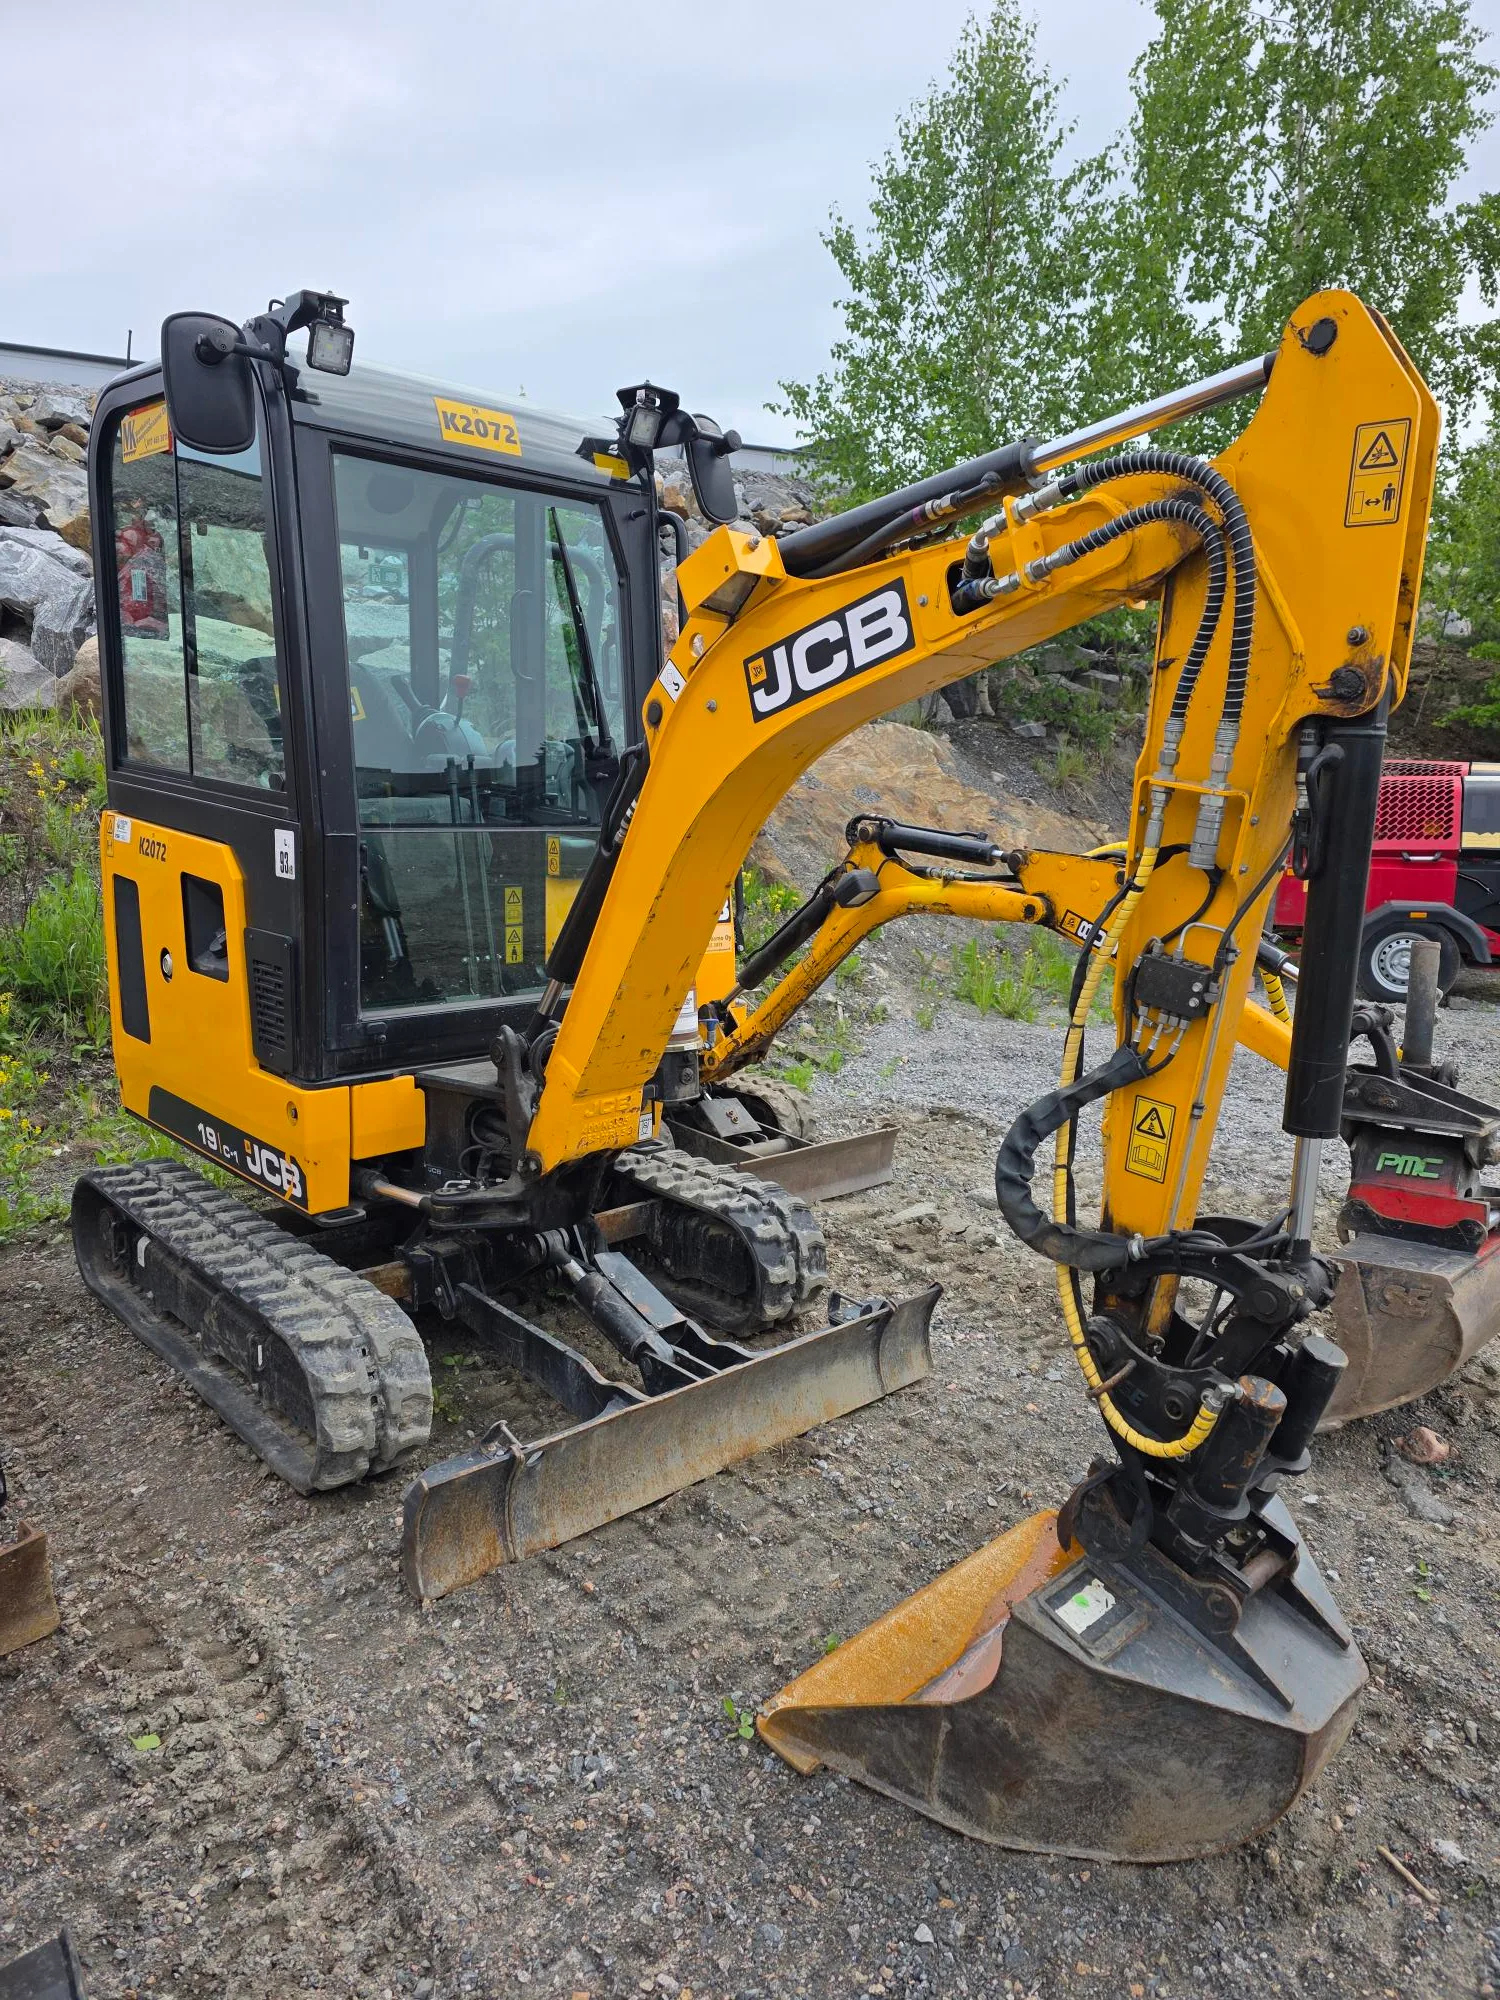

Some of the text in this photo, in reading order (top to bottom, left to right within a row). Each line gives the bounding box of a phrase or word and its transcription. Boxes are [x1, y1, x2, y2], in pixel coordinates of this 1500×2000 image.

[442, 410, 518, 445] K2072
[753, 590, 908, 713] JCB
[139, 836, 167, 862] K2072
[280, 850, 289, 874] 93
[197, 1122, 218, 1151] 19
[246, 1143, 302, 1198] JCB
[1375, 1152, 1444, 1178] PMC
